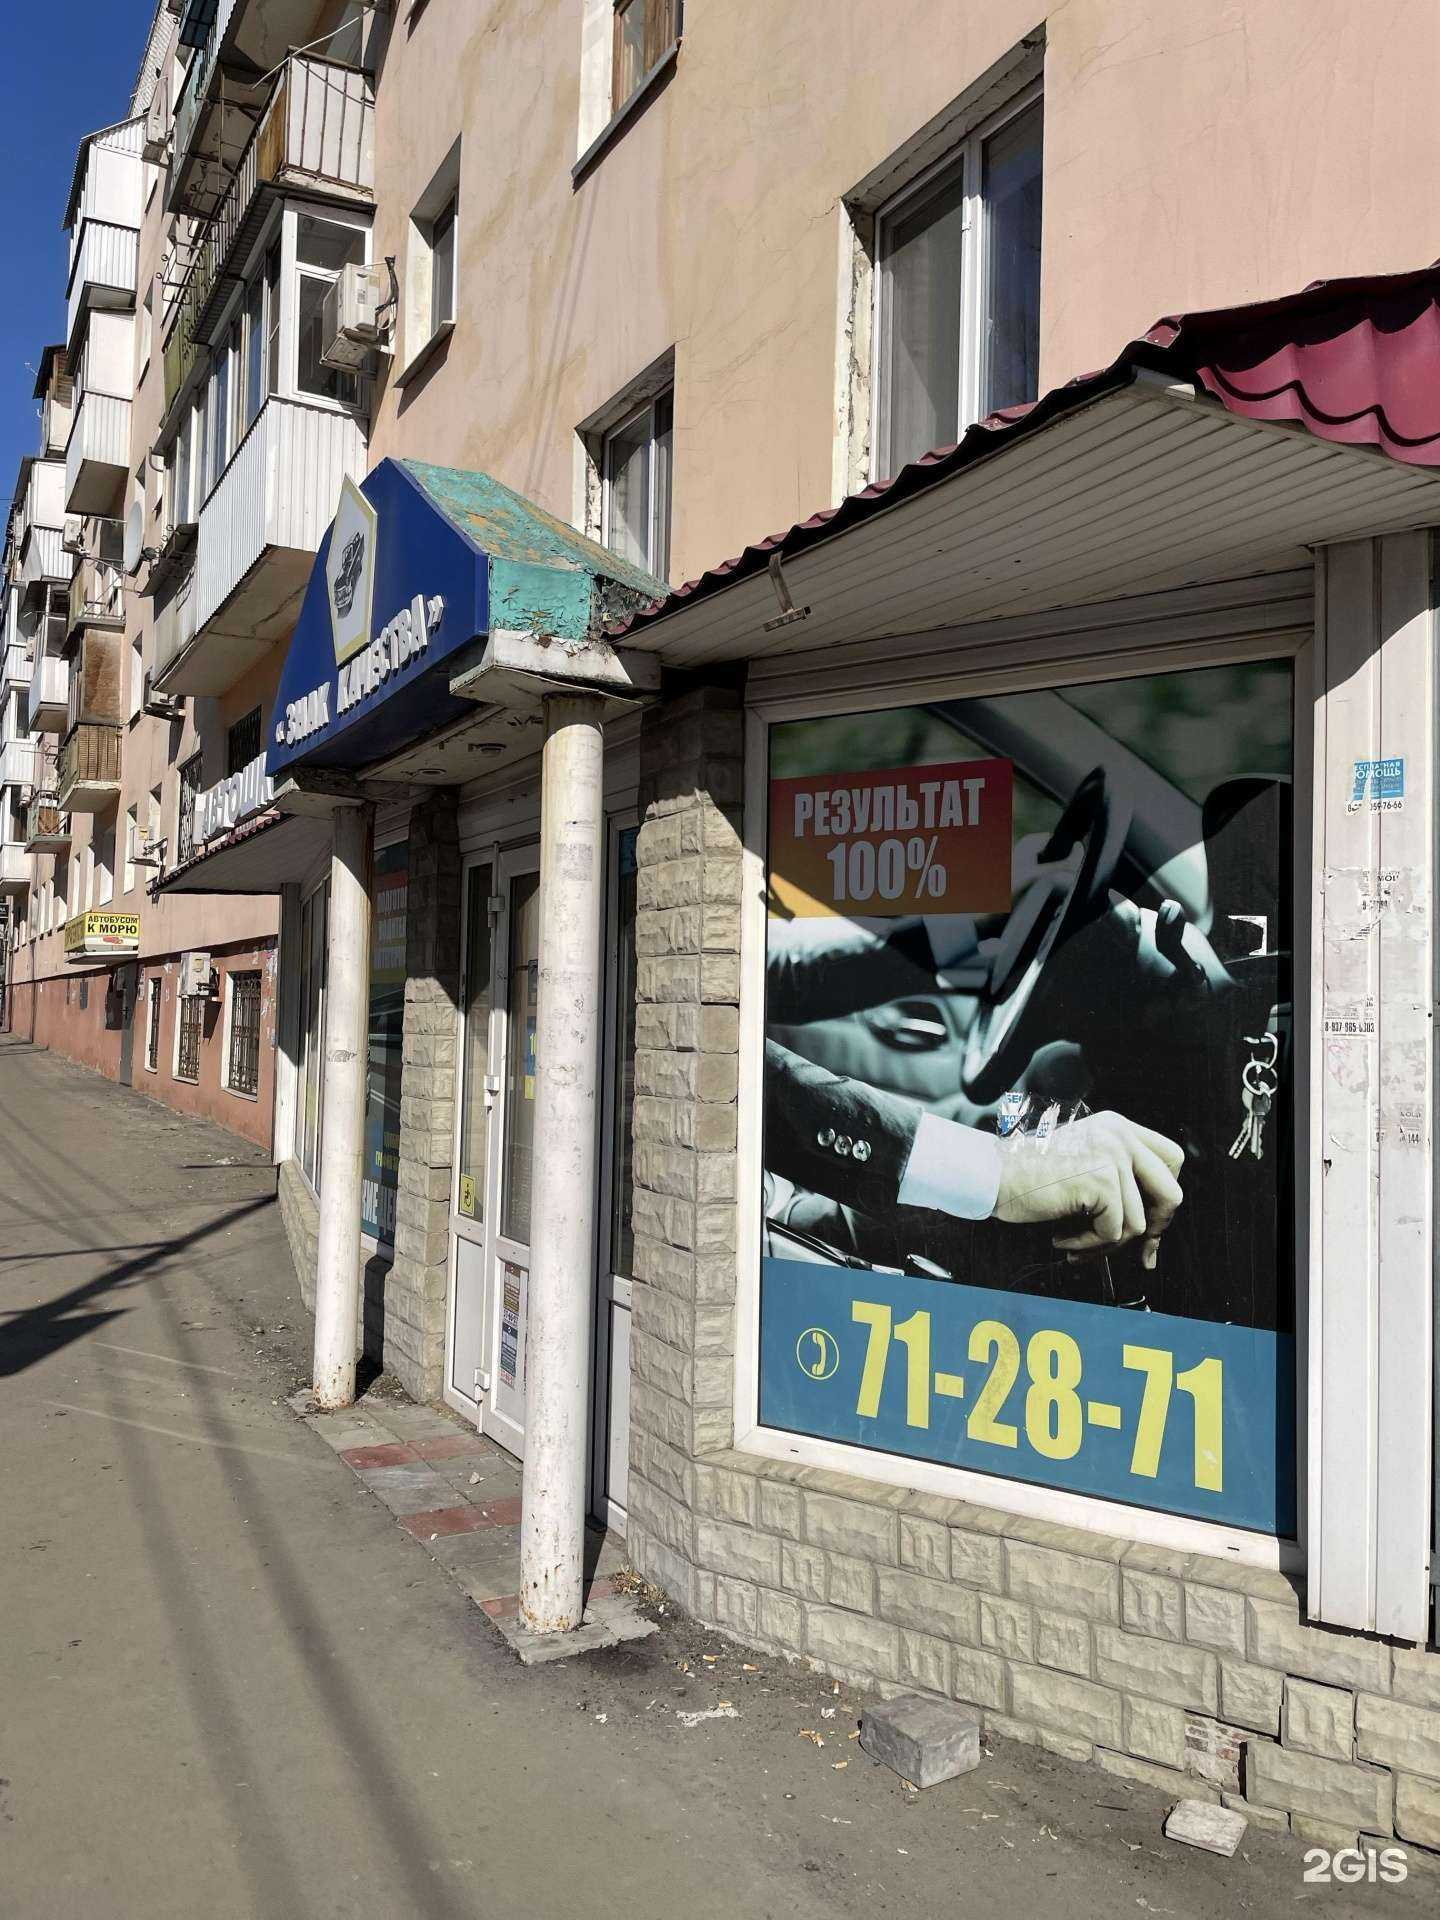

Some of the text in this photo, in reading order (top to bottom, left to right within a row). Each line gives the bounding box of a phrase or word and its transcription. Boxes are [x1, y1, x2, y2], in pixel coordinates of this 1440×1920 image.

[1356, 767, 1402, 780] ОМОЩЬ
[794, 778, 986, 837] РЕЗУЛЬТАТ
[826, 835, 947, 901] 100%
[87, 915, 138, 924] АВТОБУСОМ
[87, 923, 138, 934] К МОРЮ
[851, 1299, 1223, 1493] 71-28-71
